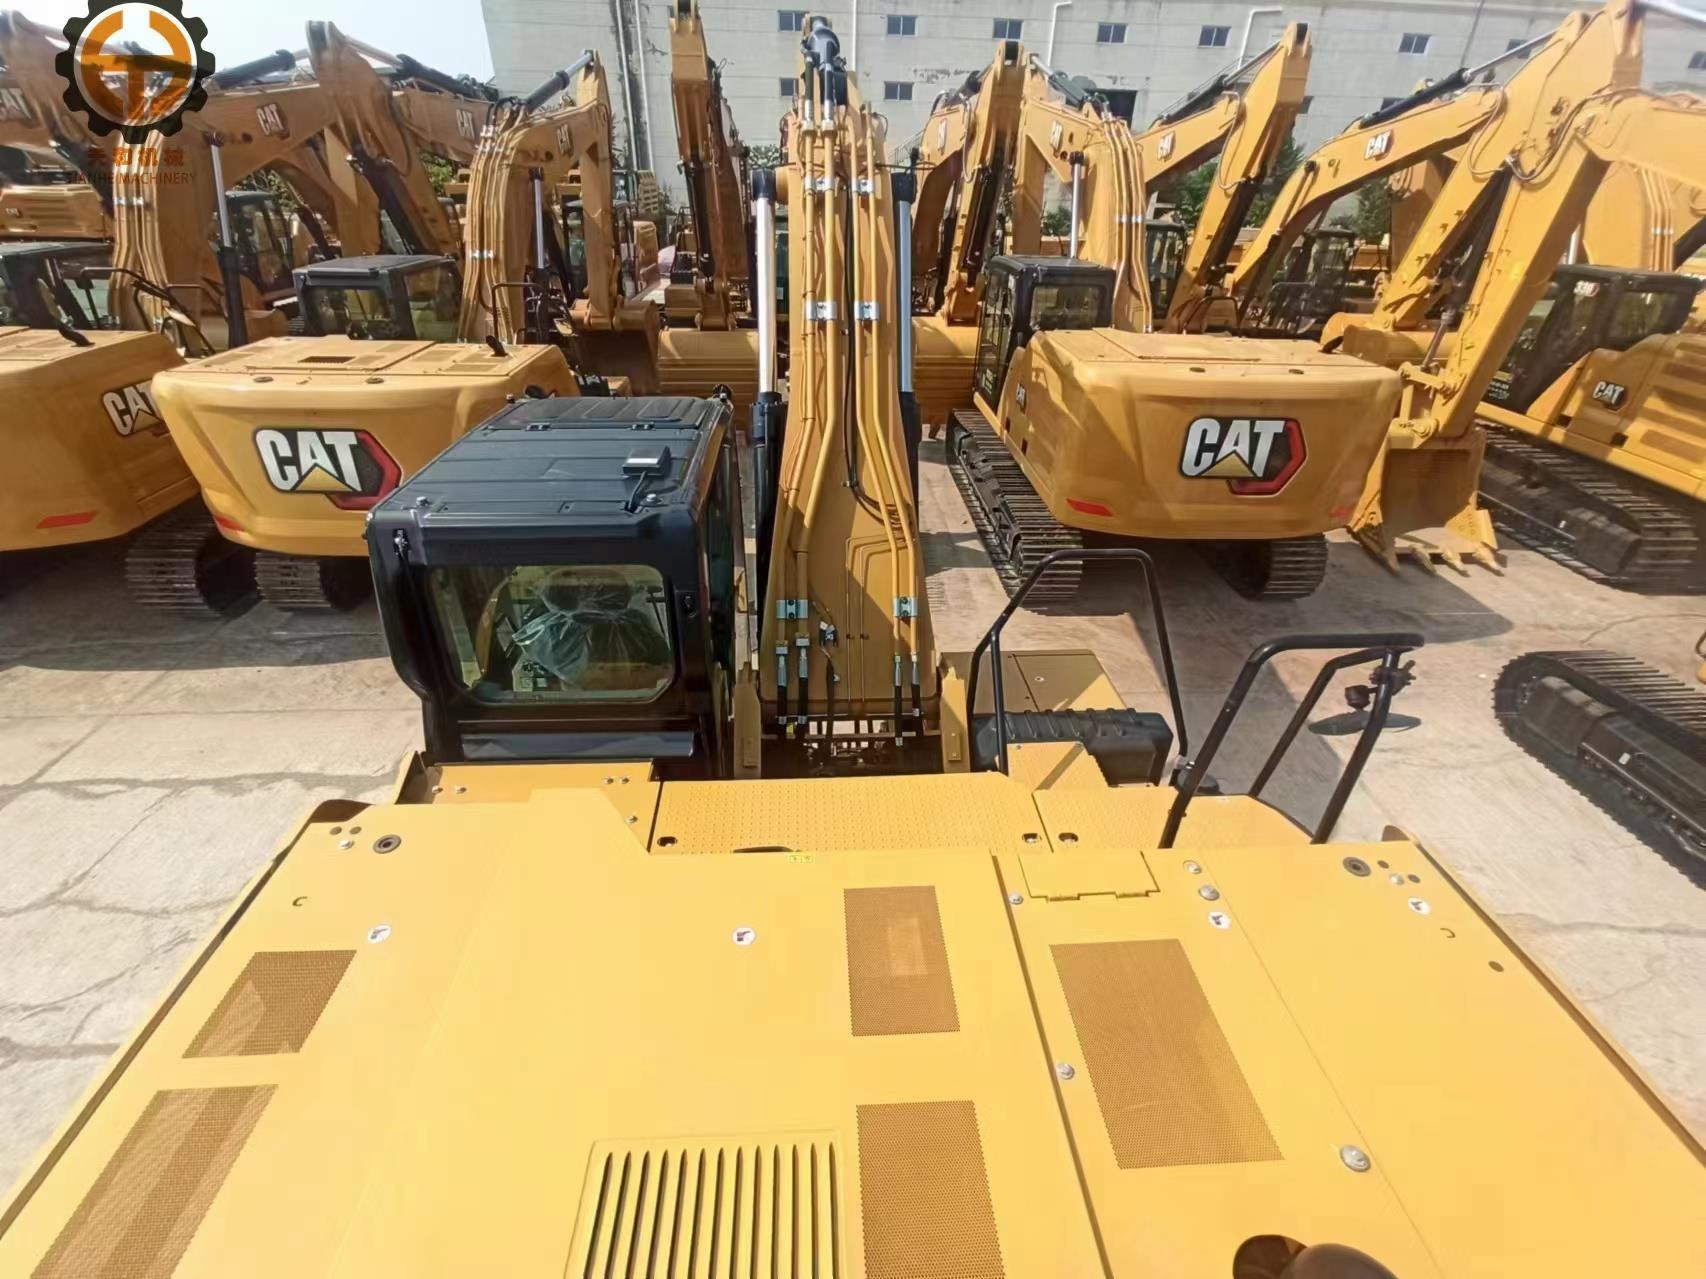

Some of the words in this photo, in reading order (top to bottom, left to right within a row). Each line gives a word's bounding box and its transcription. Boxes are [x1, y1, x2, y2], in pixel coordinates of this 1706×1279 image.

[256, 103, 285, 136] CAT
[455, 108, 476, 141] CAT
[1364, 129, 1392, 160] CAT
[1593, 381, 1625, 405] CAT
[256, 429, 363, 493] CAT
[1183, 418, 1287, 479] CAT
